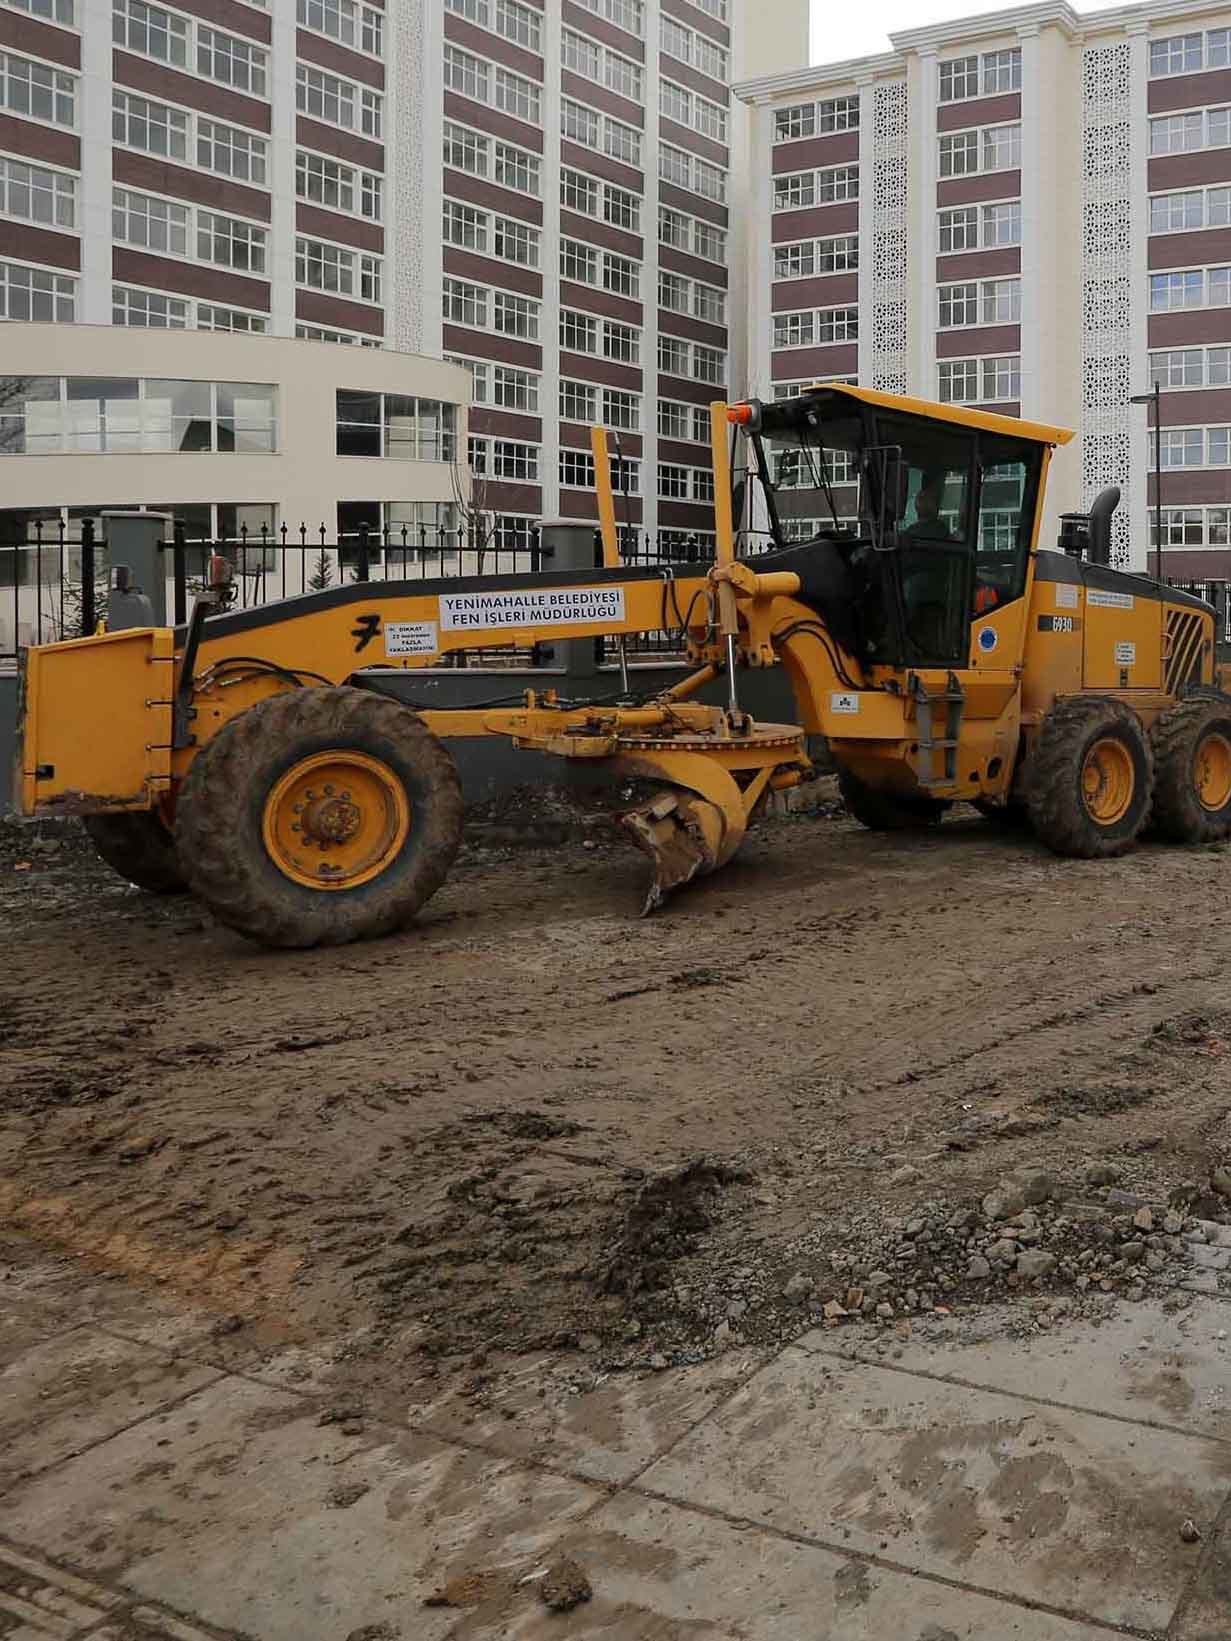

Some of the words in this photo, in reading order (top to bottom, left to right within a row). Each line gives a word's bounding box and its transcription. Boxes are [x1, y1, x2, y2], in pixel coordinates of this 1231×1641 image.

[446, 595, 545, 610] YENİMAHALLE
[550, 590, 620, 605] BELEDİYESİ
[452, 613, 479, 625] FEN
[485, 609, 526, 625] İŞLERİ
[530, 604, 616, 620] MÜDÜRLÜĞÜ
[351, 615, 382, 653] 7
